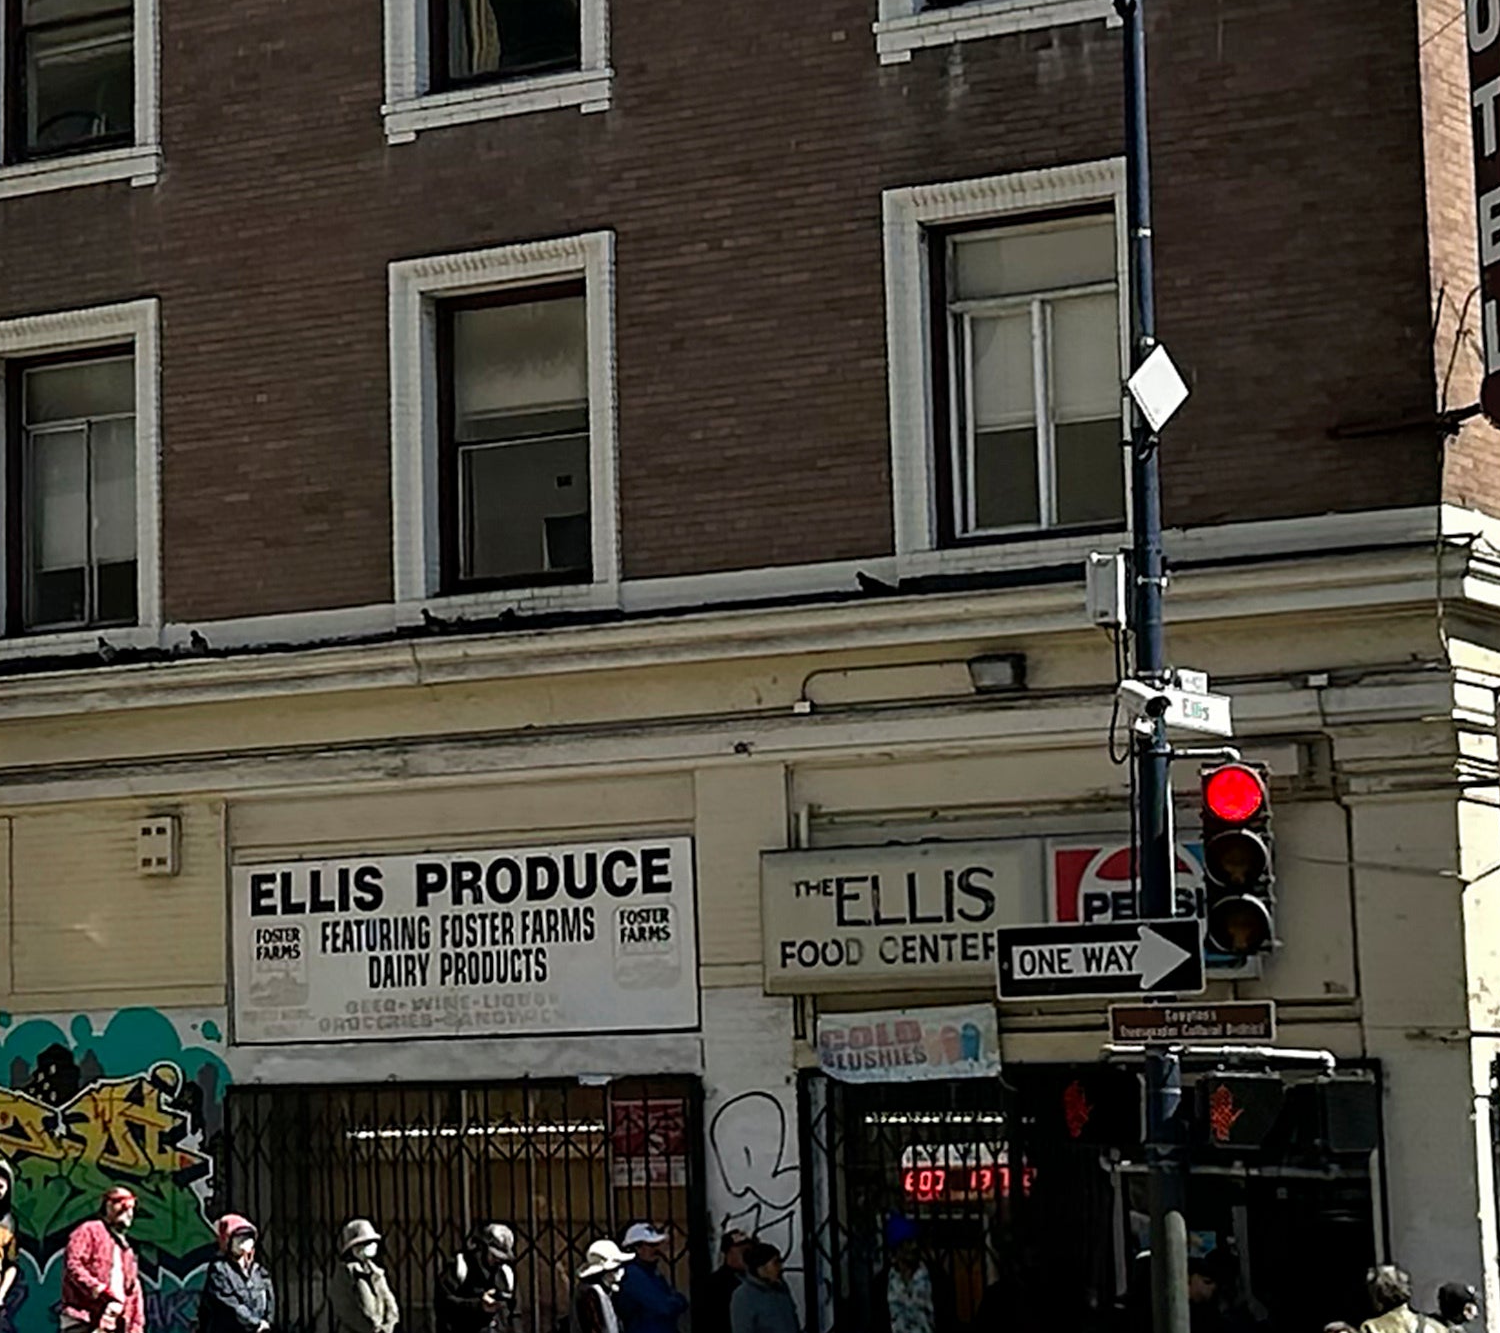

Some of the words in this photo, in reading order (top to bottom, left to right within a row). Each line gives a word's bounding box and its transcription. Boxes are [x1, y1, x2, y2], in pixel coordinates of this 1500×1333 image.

[250, 865, 384, 917] ELLIS
[416, 847, 673, 908] PRODUCE
[793, 878, 834, 899] THE
[835, 866, 997, 928] ELLIS
[619, 907, 670, 925] FOSTER
[1084, 887, 1205, 924] PESI
[256, 927, 301, 944] FOSTER
[320, 916, 431, 954] FEATURING
[441, 911, 515, 948] FOSTER
[521, 906, 596, 944] FARMS
[620, 924, 672, 944] FARMS
[256, 943, 301, 961] FARMS
[368, 953, 430, 989] DAIRY
[440, 947, 548, 986] PRODUCTS
[780, 937, 864, 969] FOOD
[1019, 948, 1075, 976] ONE
[1082, 944, 1140, 974] WAY
[820, 1020, 922, 1050] COLD
